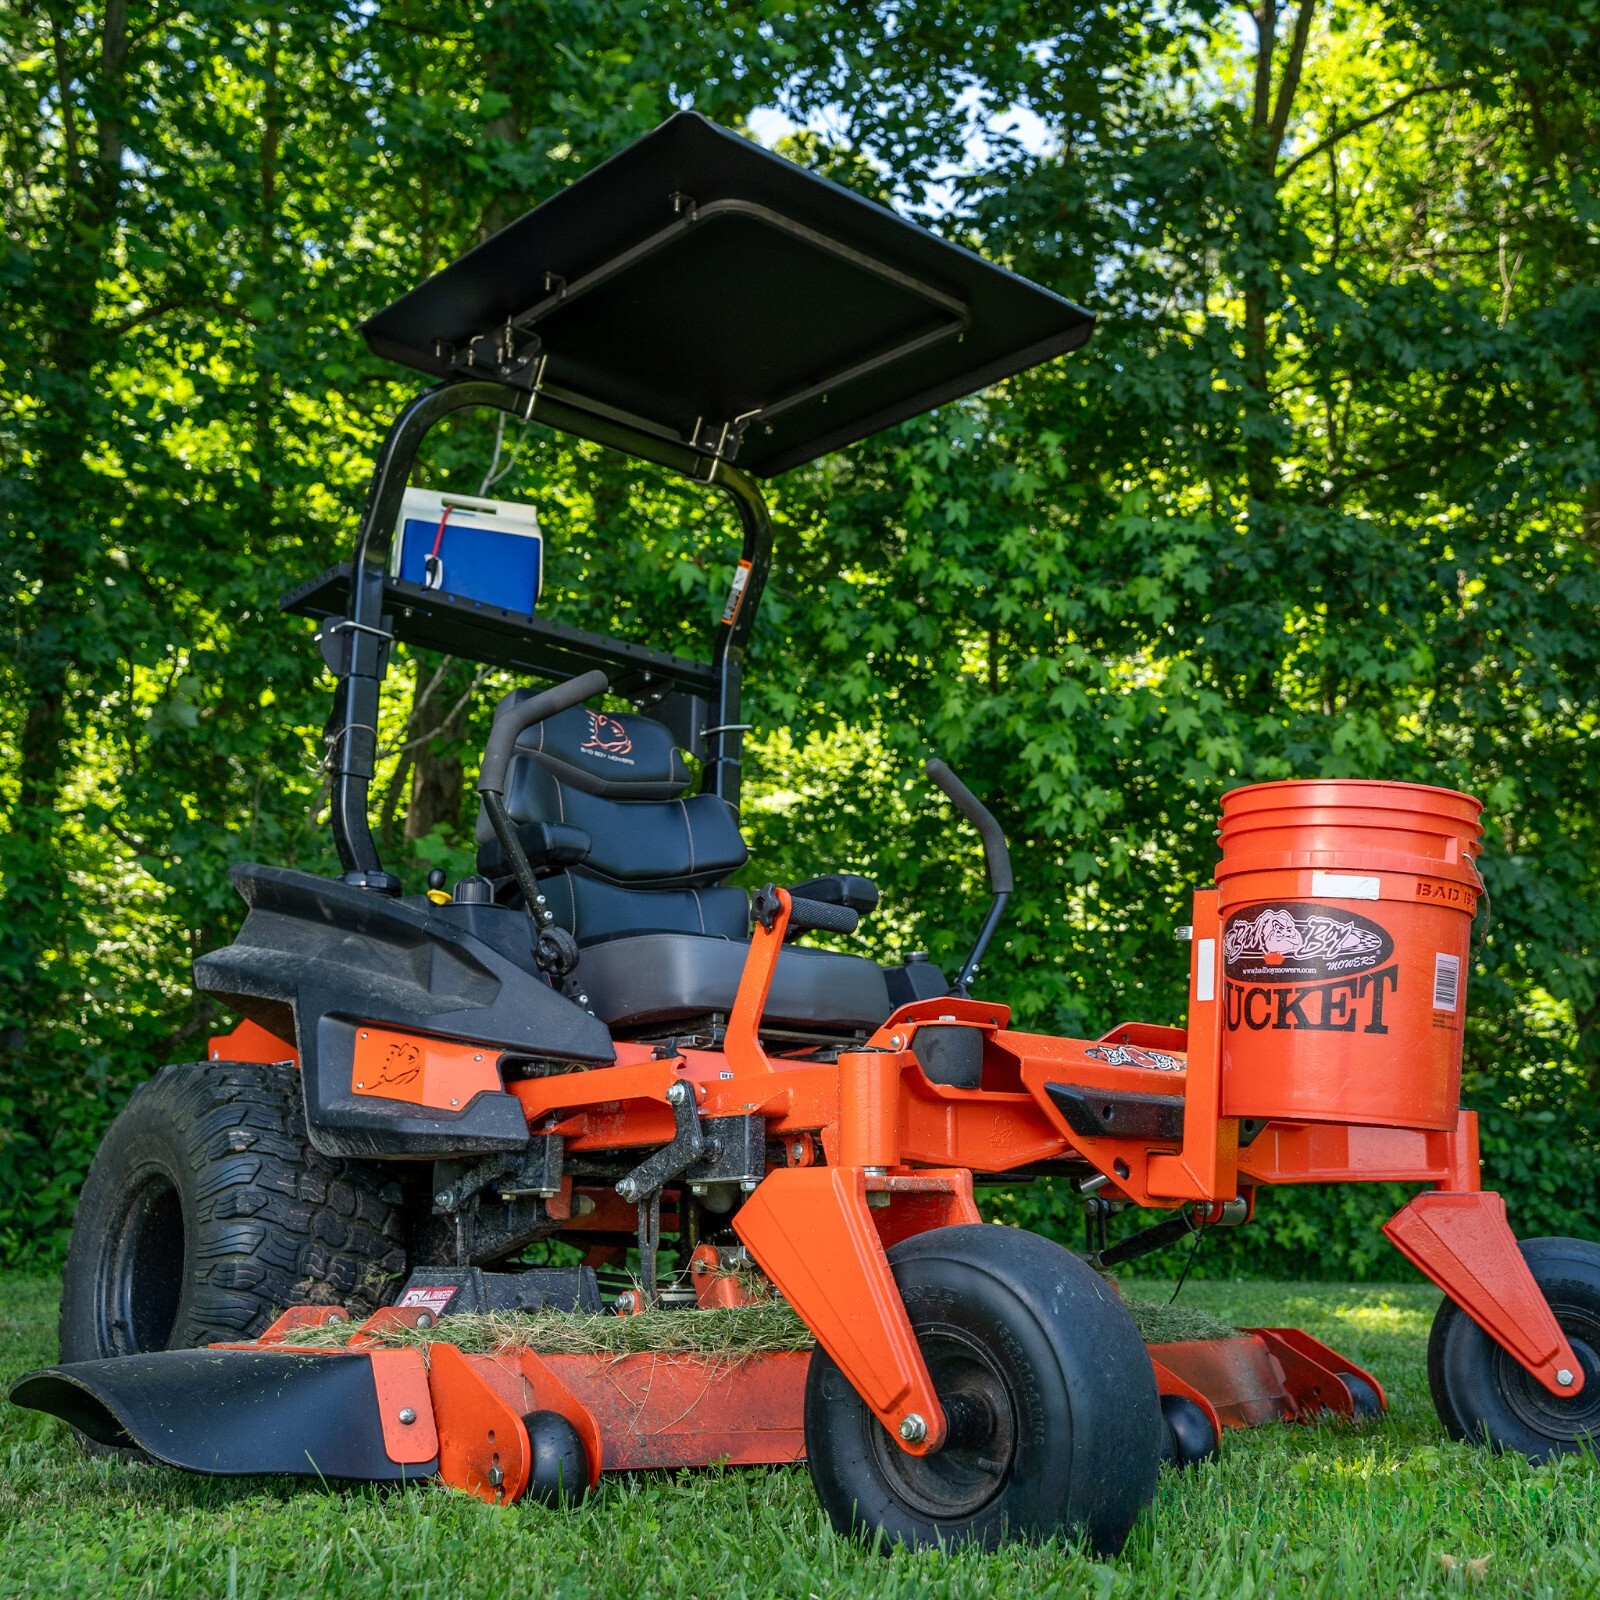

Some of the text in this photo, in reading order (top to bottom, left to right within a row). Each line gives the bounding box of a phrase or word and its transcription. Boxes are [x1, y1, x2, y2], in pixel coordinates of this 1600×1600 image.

[1416, 883, 1459, 901] BAD
[1326, 955, 1376, 970] MOWERS
[1224, 964, 1398, 1034] UCKET
[901, 1284, 960, 1305] SLE
